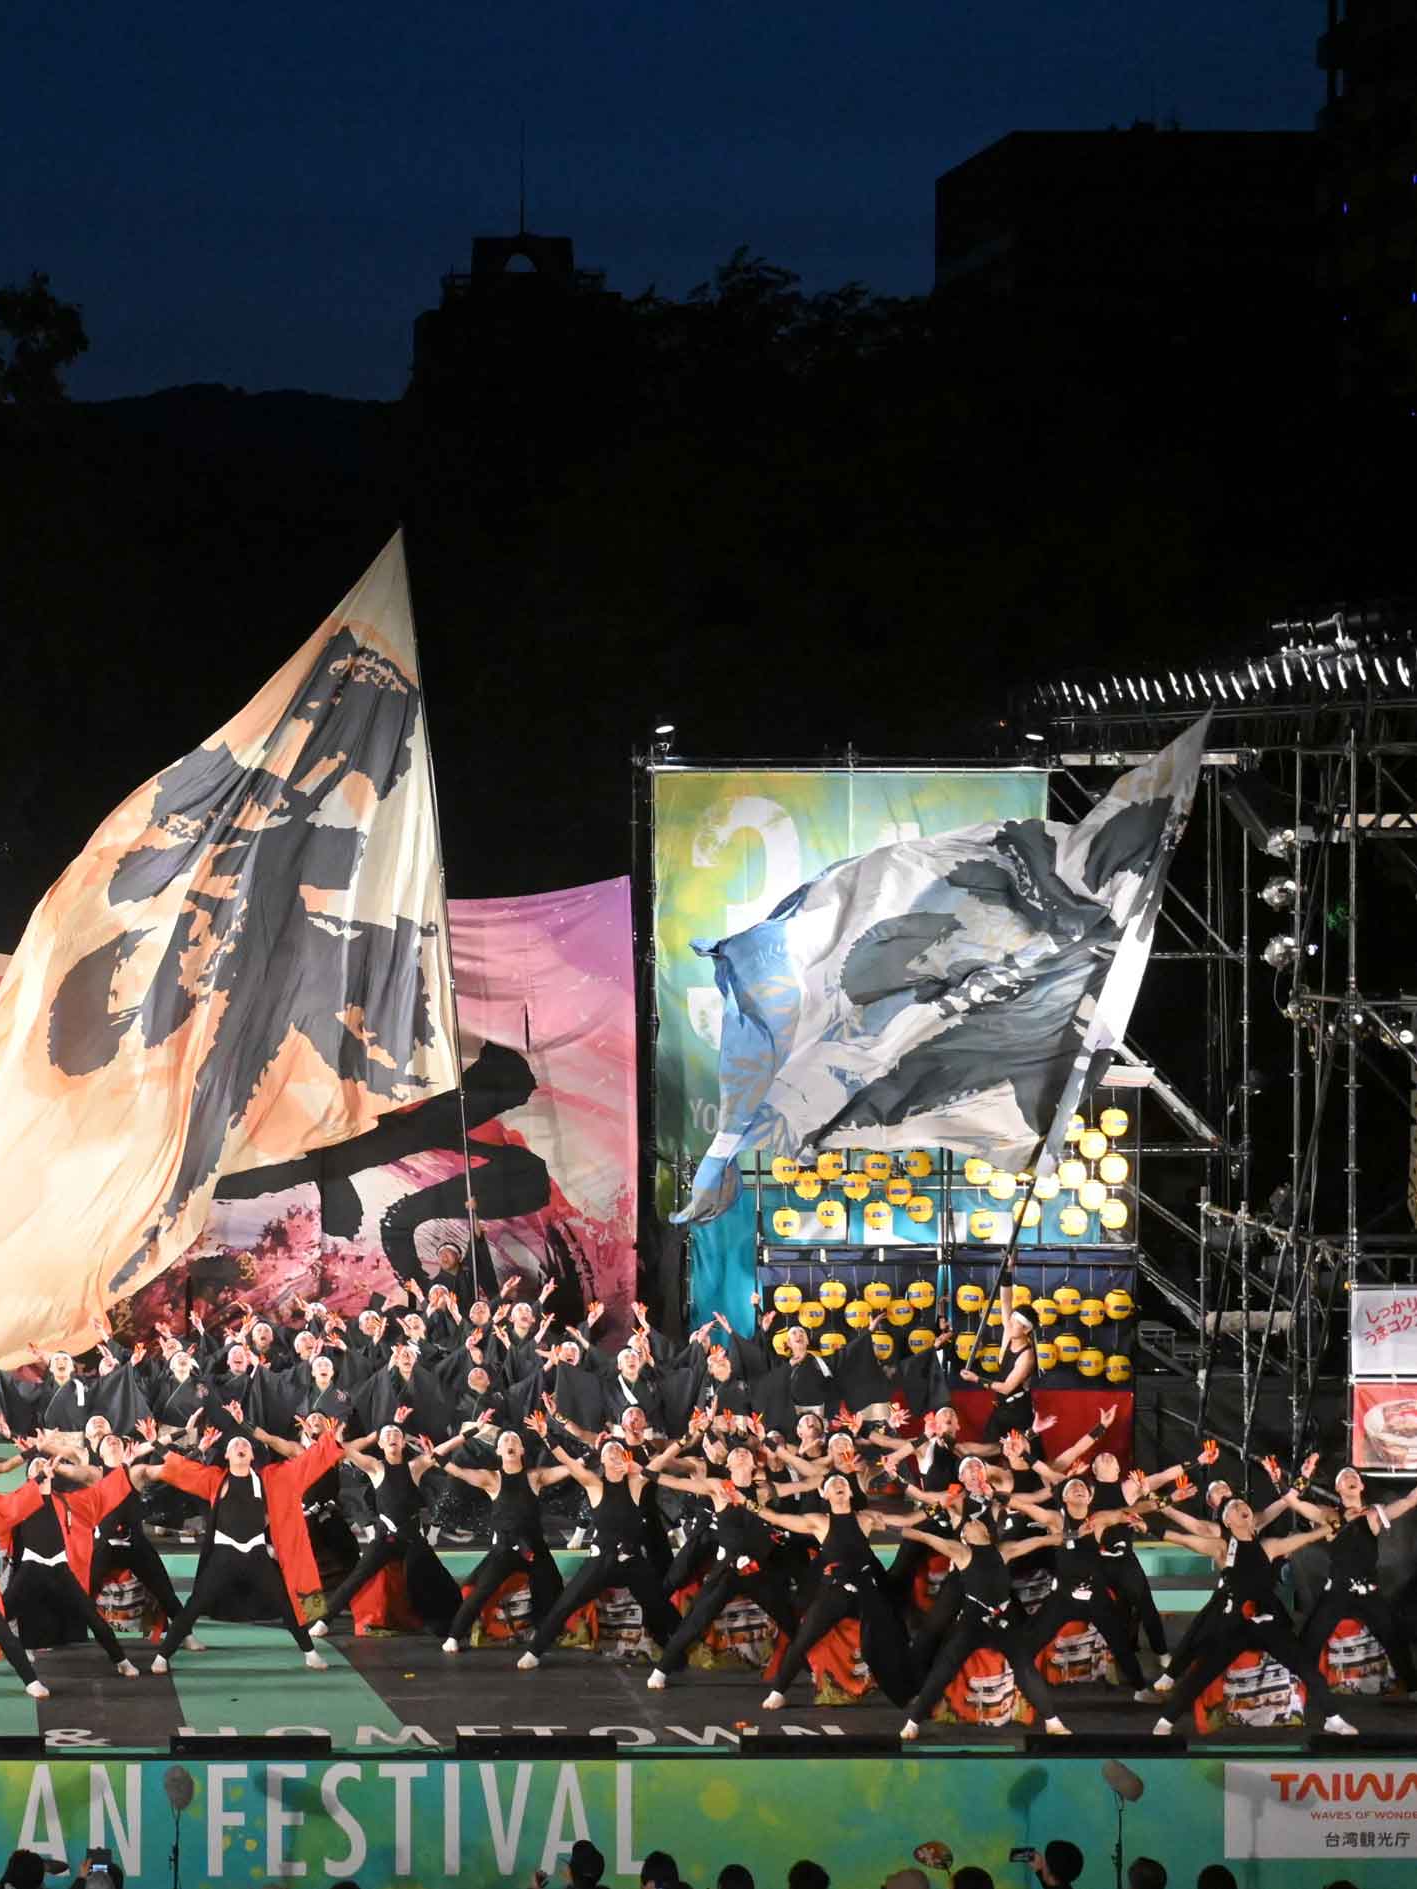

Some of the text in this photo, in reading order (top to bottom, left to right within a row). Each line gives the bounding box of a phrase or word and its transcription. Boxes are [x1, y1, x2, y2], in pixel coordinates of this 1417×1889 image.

[1362, 1315, 1417, 1346] うまコク
[44, 1728, 112, 1747] &
[207, 1762, 644, 1877] FESTIVAL
[1311, 1810, 1352, 1821] WAVES
[1355, 1810, 1371, 1821] OF
[1325, 1831, 1412, 1849] 台湾観光庁
